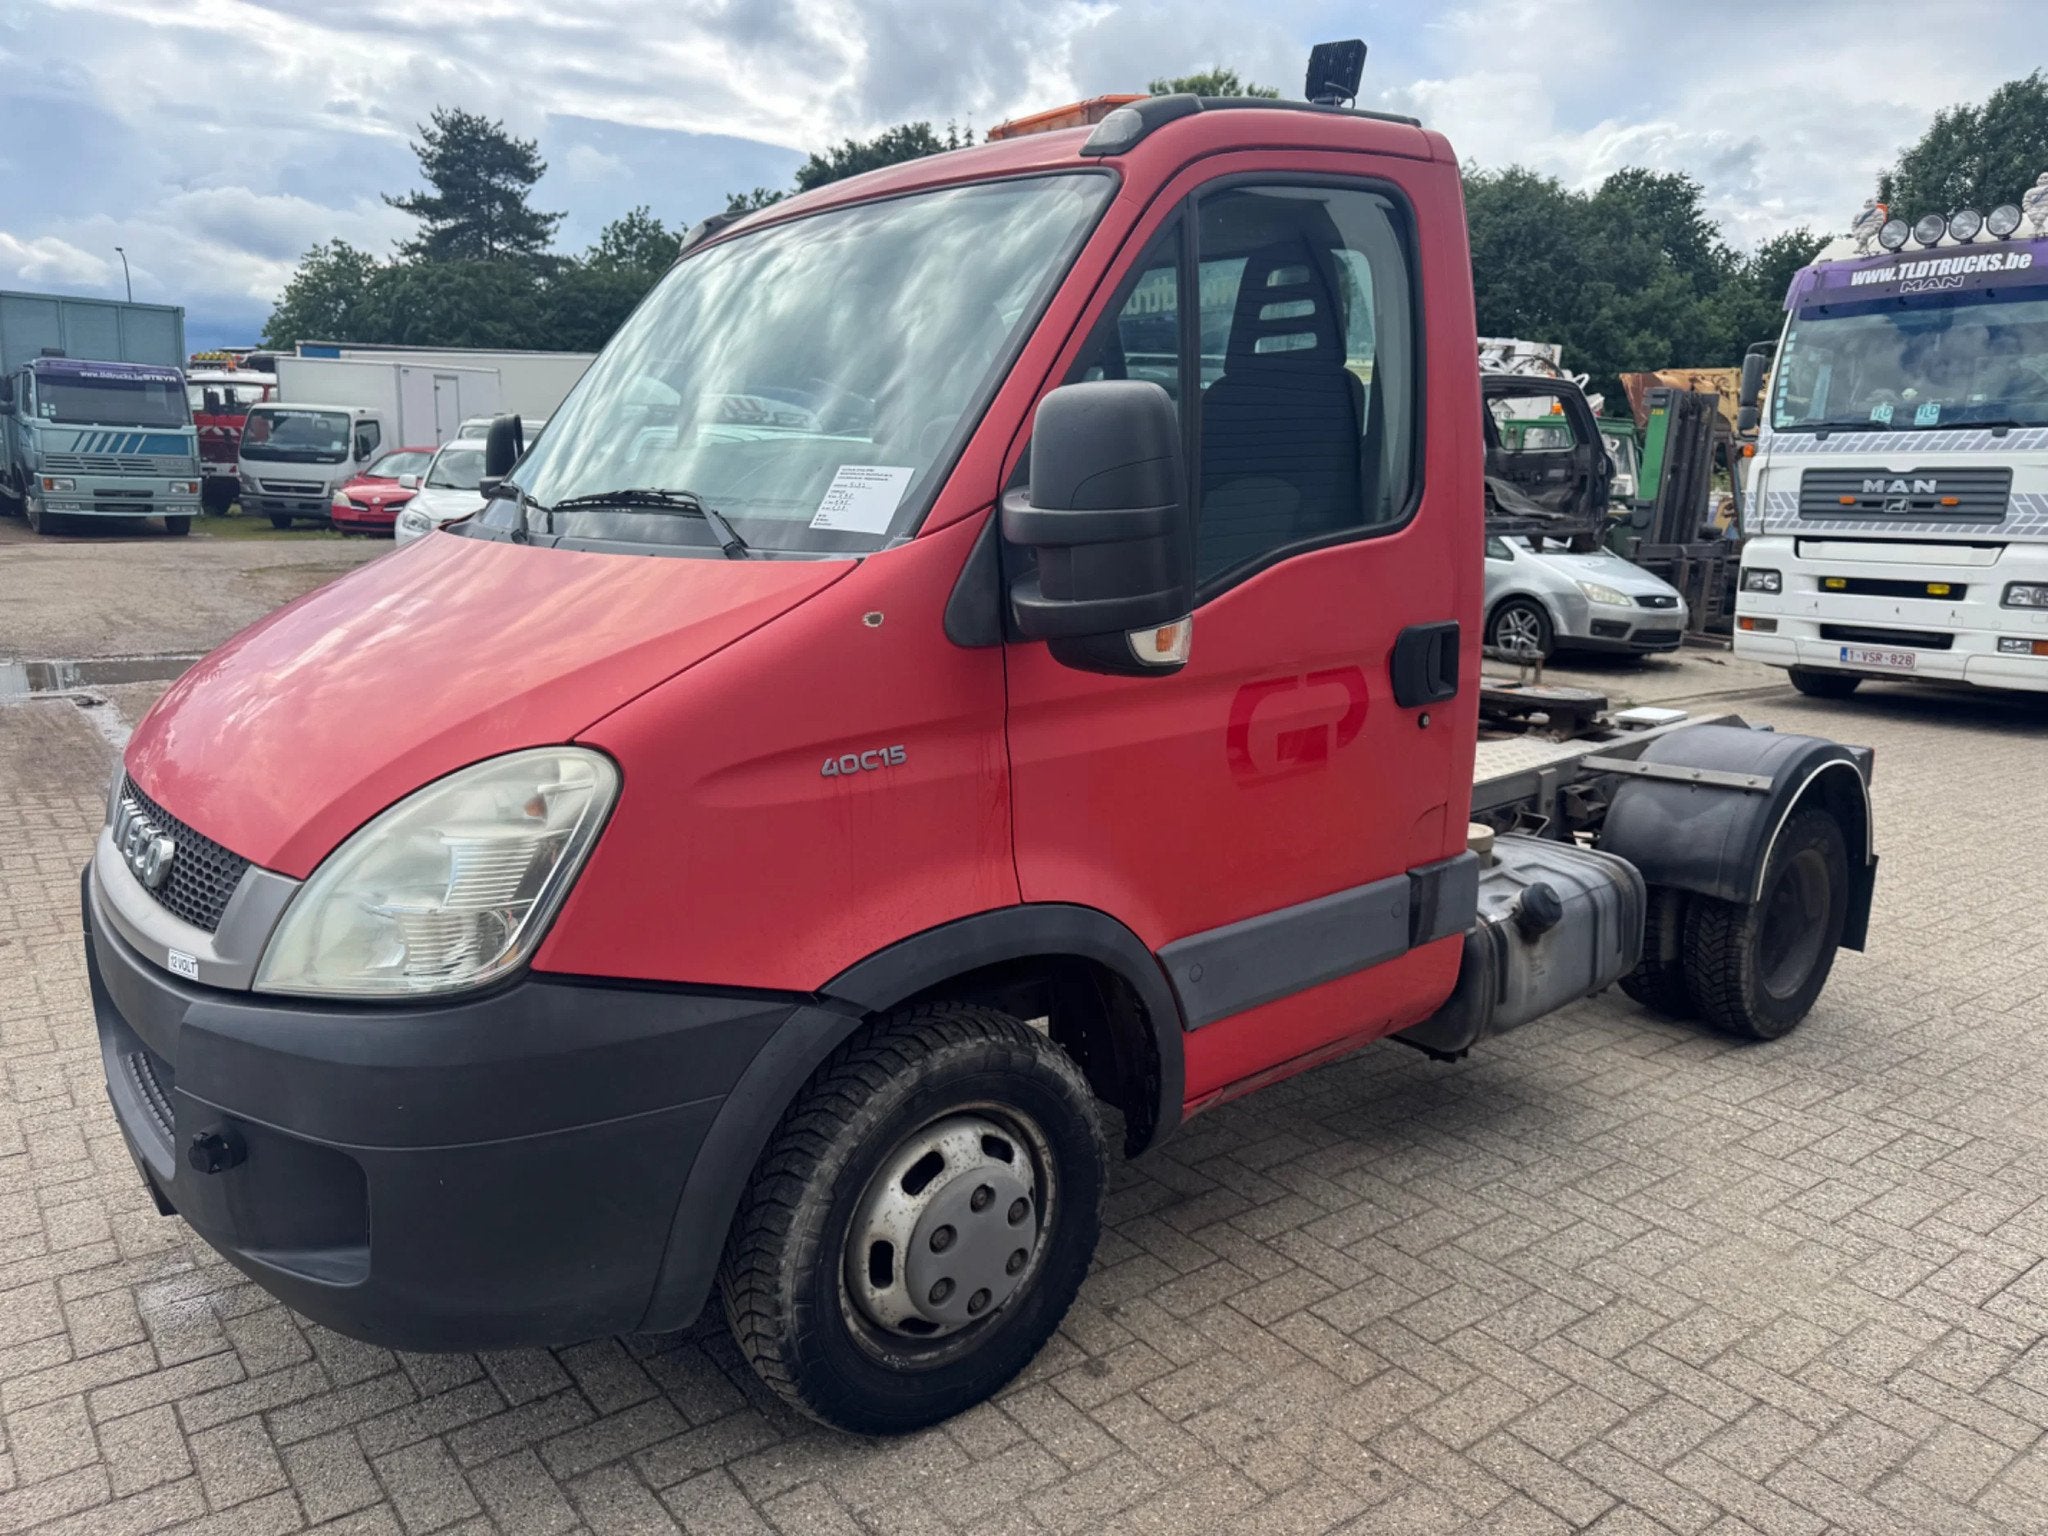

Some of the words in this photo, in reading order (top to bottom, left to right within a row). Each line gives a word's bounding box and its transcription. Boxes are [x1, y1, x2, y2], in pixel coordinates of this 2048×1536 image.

[1851, 251, 2032, 286] www.TLDTRUCKS.be
[1900, 275, 1965, 293] MAN
[1862, 479, 1937, 493] MAN
[821, 744, 907, 776] 40C15
[178, 956, 197, 974] VOLT
